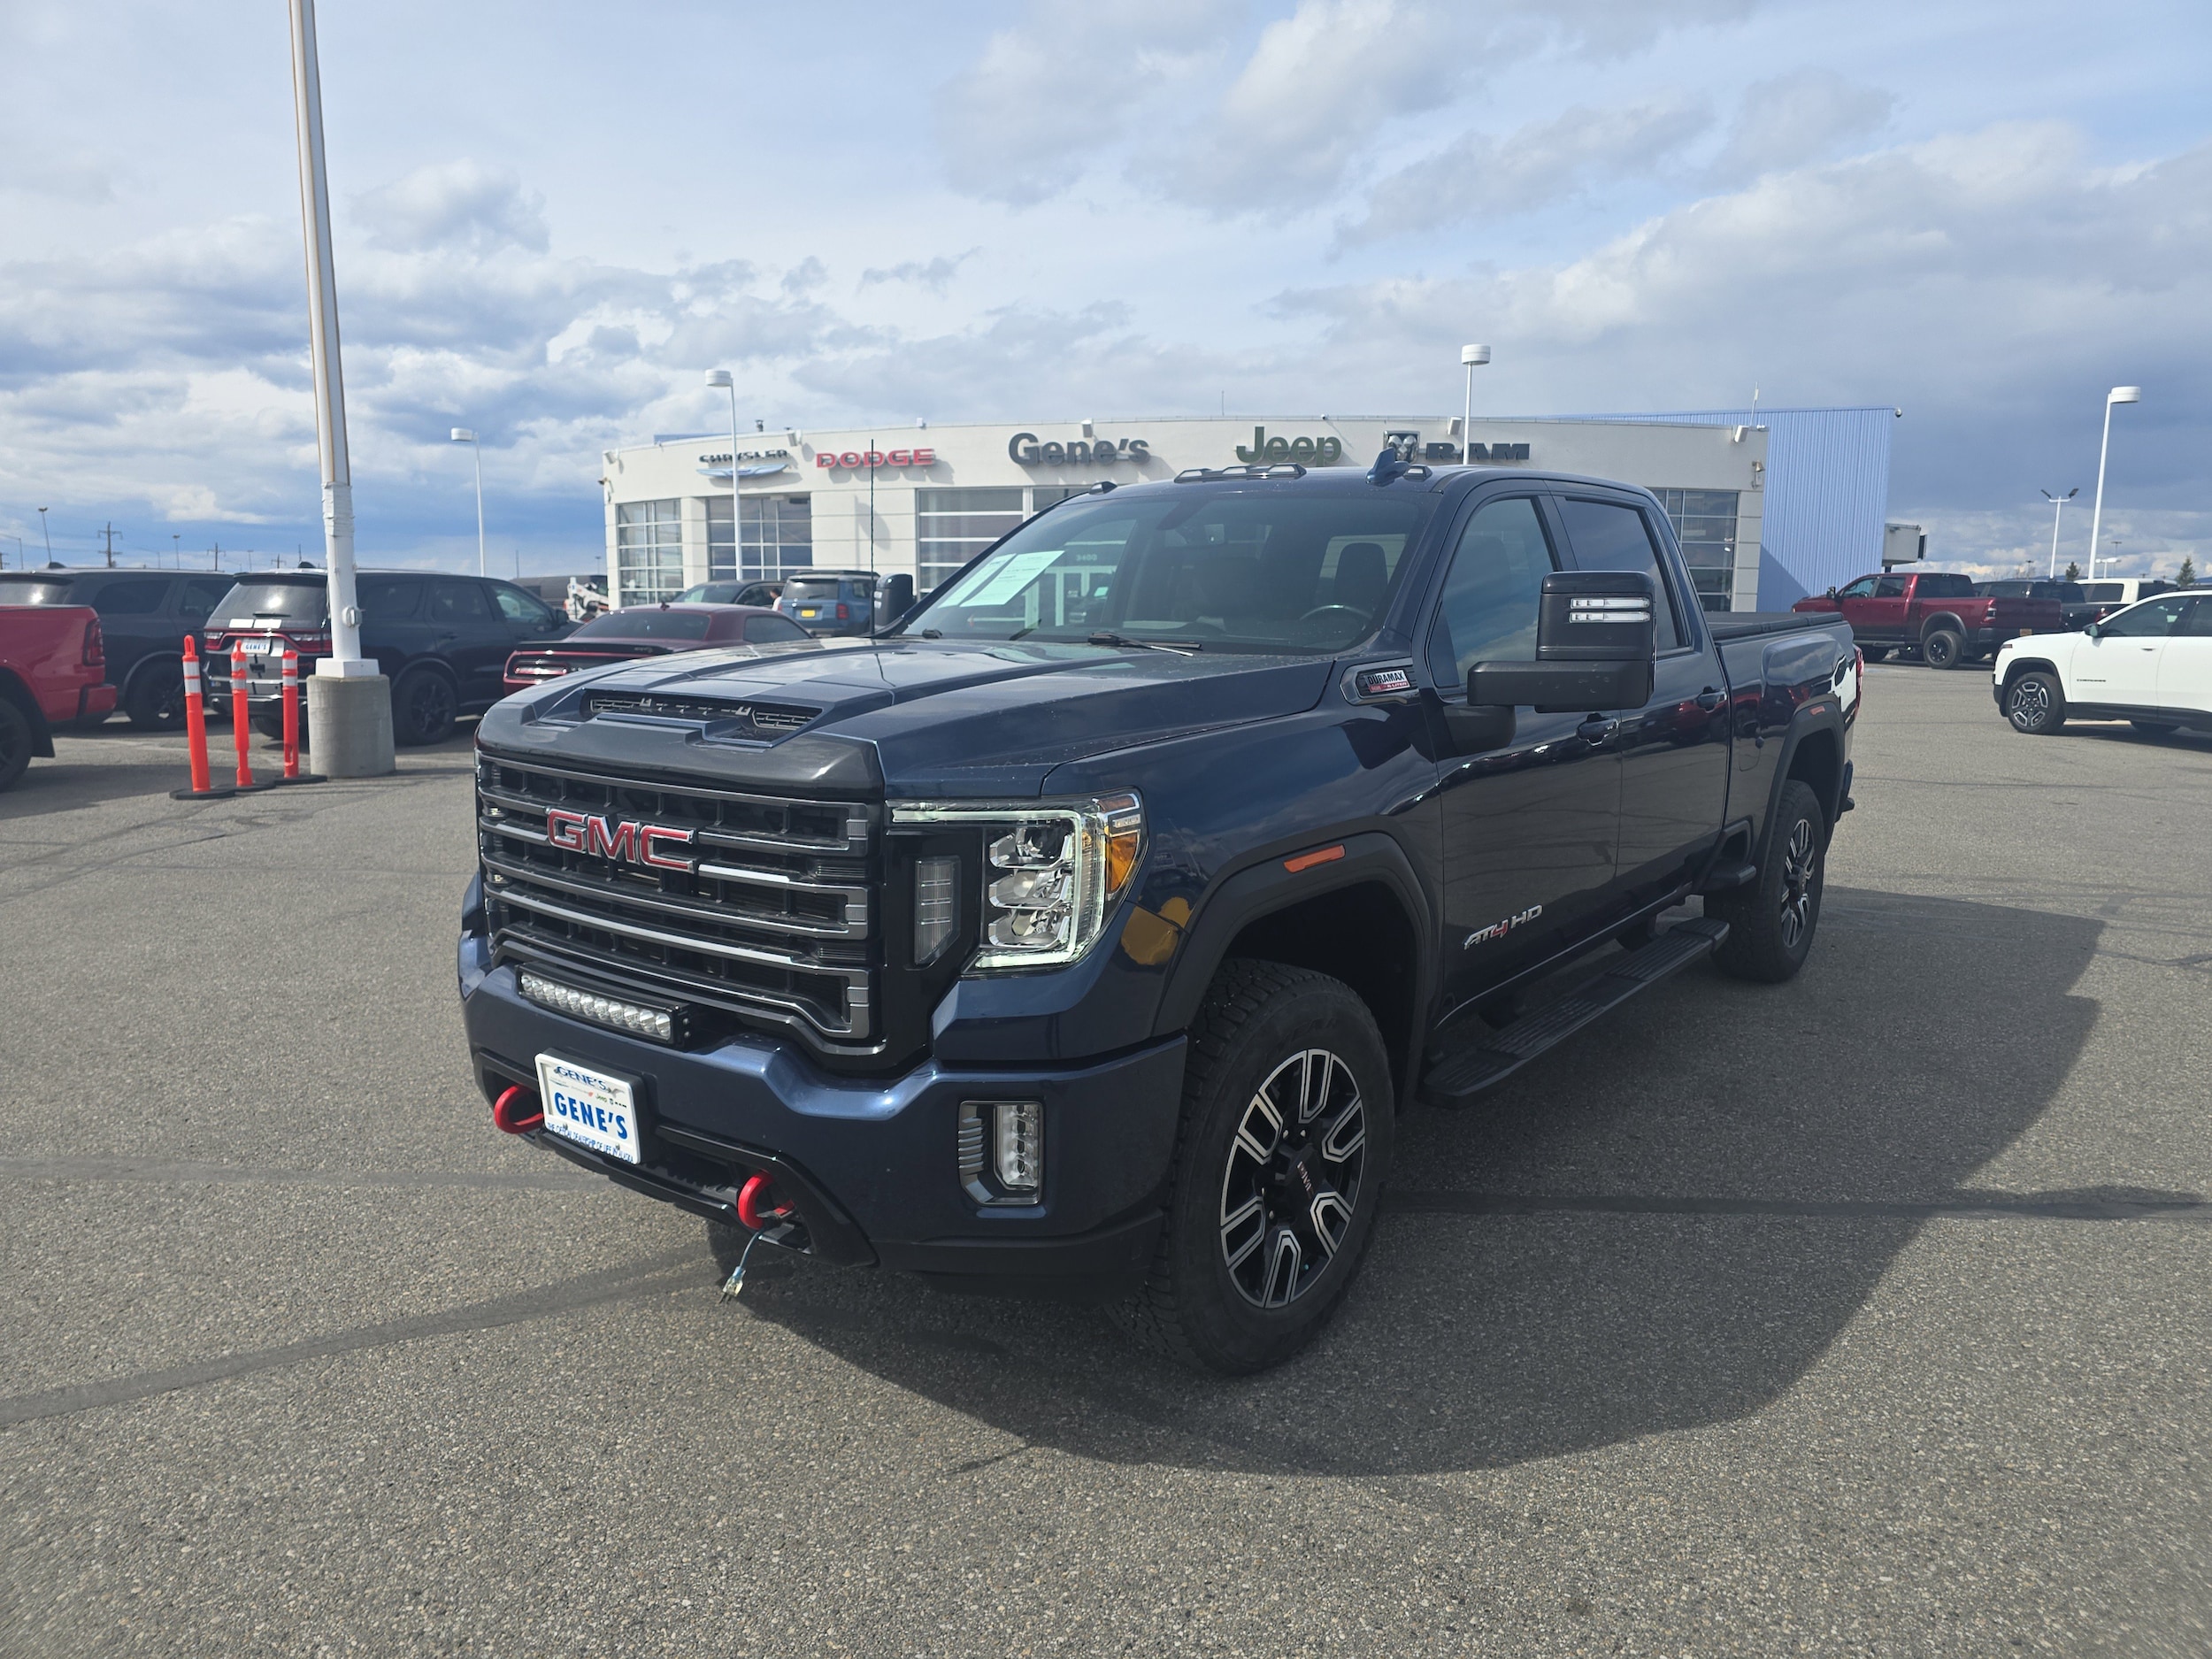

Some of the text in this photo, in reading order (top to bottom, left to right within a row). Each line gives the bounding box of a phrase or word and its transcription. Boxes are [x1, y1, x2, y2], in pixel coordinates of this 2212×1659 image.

[816, 449, 934, 468] DODGE
[1008, 432, 1149, 465] Gene's
[1236, 426, 1341, 466] Jeep
[1425, 442, 1530, 459] RAM
[1367, 672, 1405, 685] DURAMAX
[547, 808, 695, 874] GMC
[1463, 904, 1543, 950] AT4 HD
[556, 1066, 607, 1091] GENE'S
[554, 1092, 628, 1141] GENE'S
